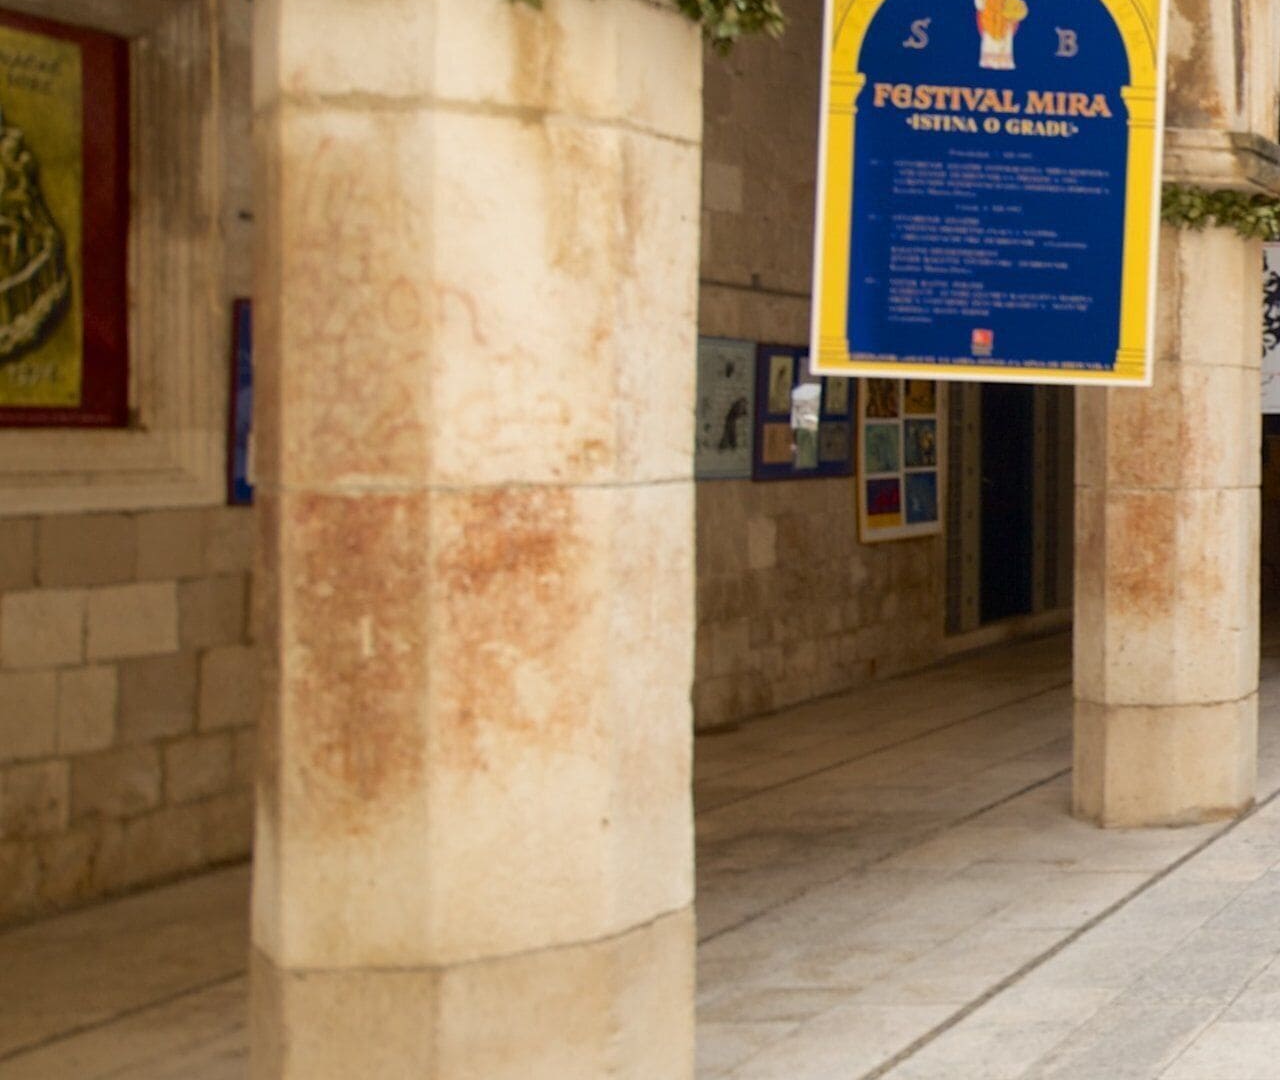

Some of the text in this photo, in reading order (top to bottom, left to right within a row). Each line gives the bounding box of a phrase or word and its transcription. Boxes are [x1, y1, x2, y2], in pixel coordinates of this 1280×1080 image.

[902, 18, 1079, 57] S B
[873, 82, 1113, 118] FESTIVAL MIRA
[983, 117, 1001, 134] O
